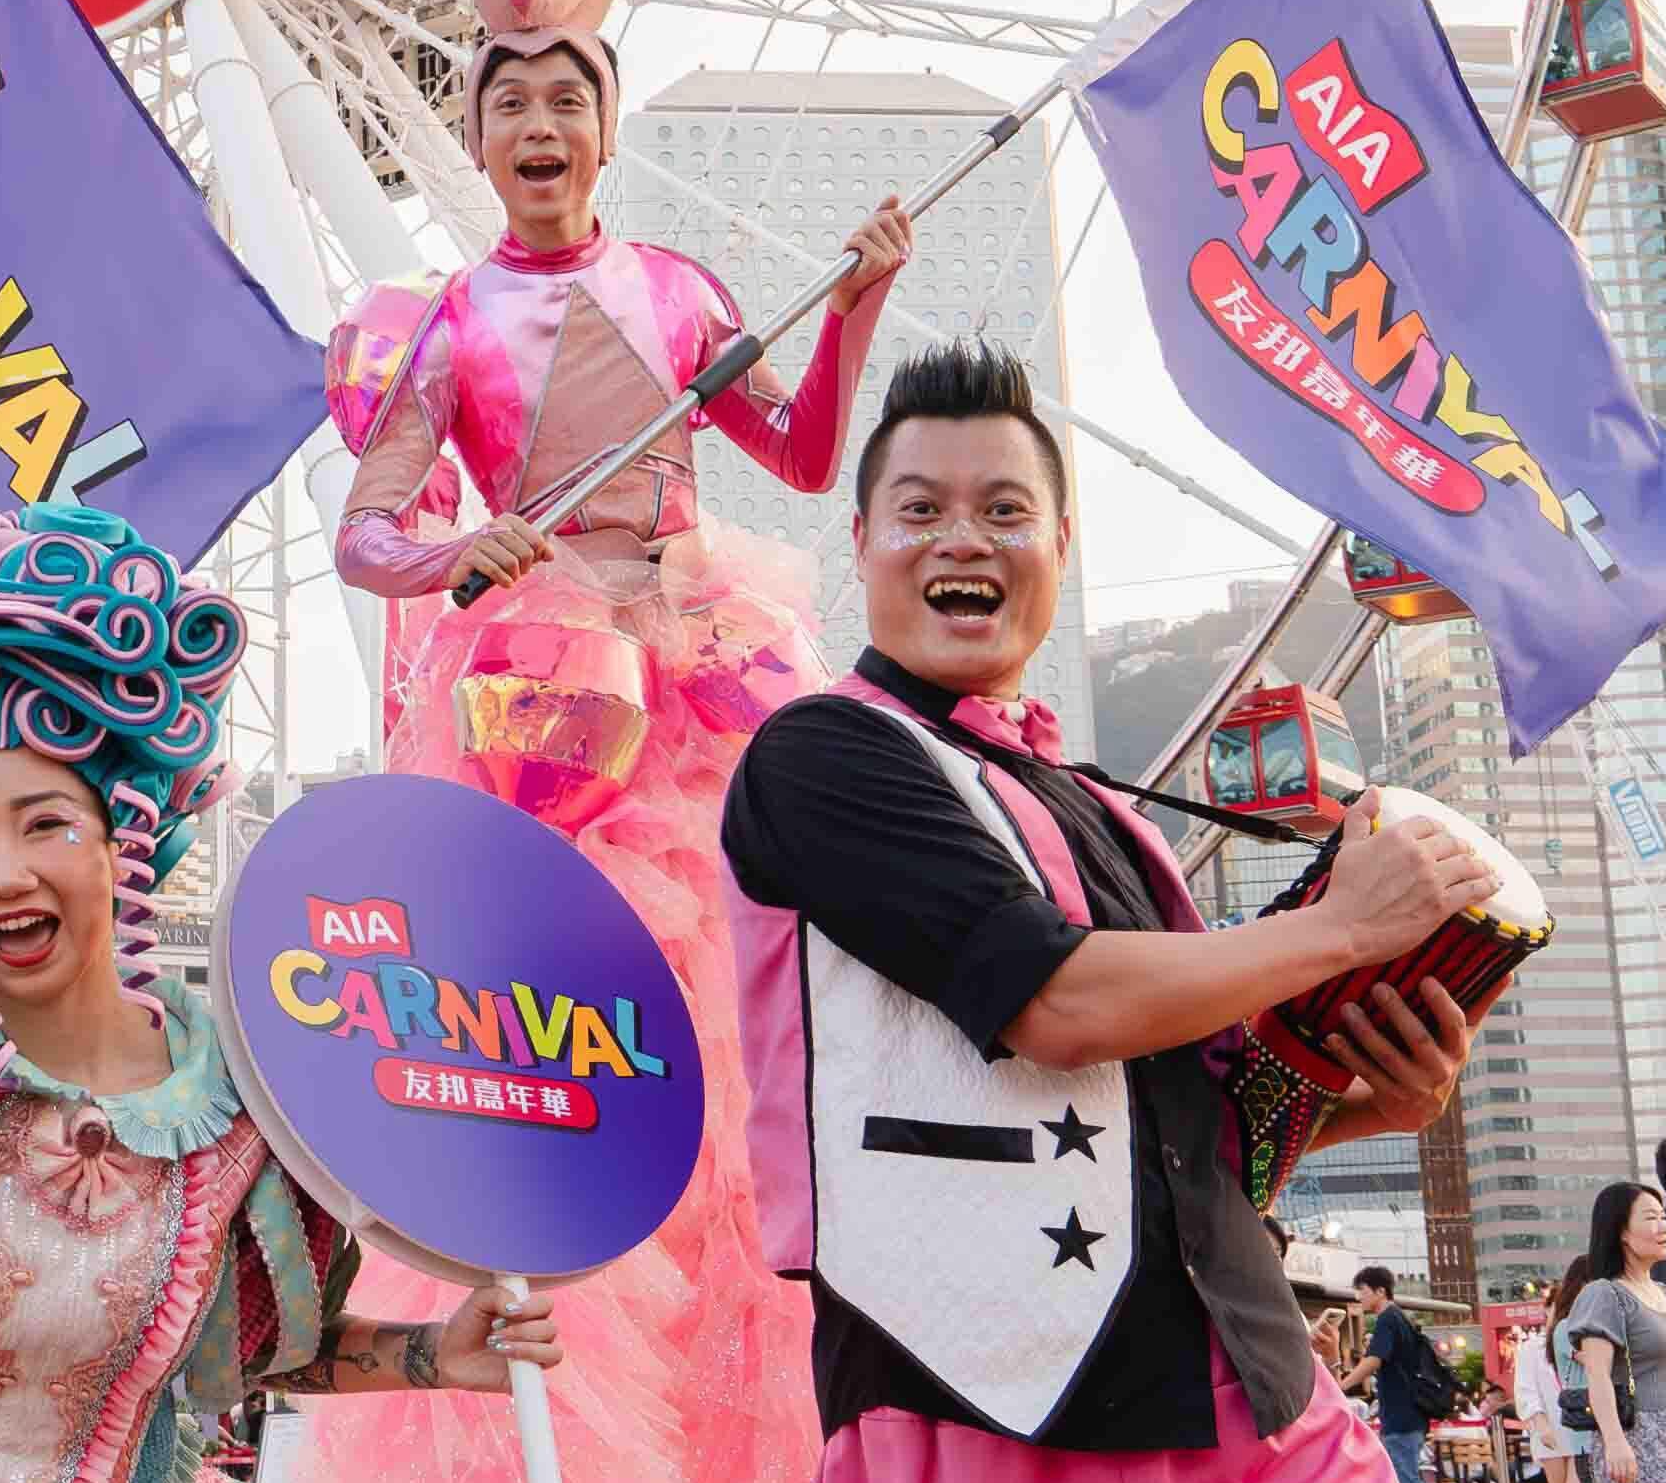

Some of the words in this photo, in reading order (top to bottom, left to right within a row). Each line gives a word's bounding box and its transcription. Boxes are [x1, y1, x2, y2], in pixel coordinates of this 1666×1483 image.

[1295, 74, 1390, 191] AIA
[1202, 39, 1620, 580] CARNIVAL
[1211, 280, 1445, 488] 友邦嘉年華
[154, 926, 204, 943] DARIN
[322, 909, 399, 945] AIA
[270, 949, 667, 1079] CARNIVAL
[402, 1068, 572, 1118] 友邦嘉年華
